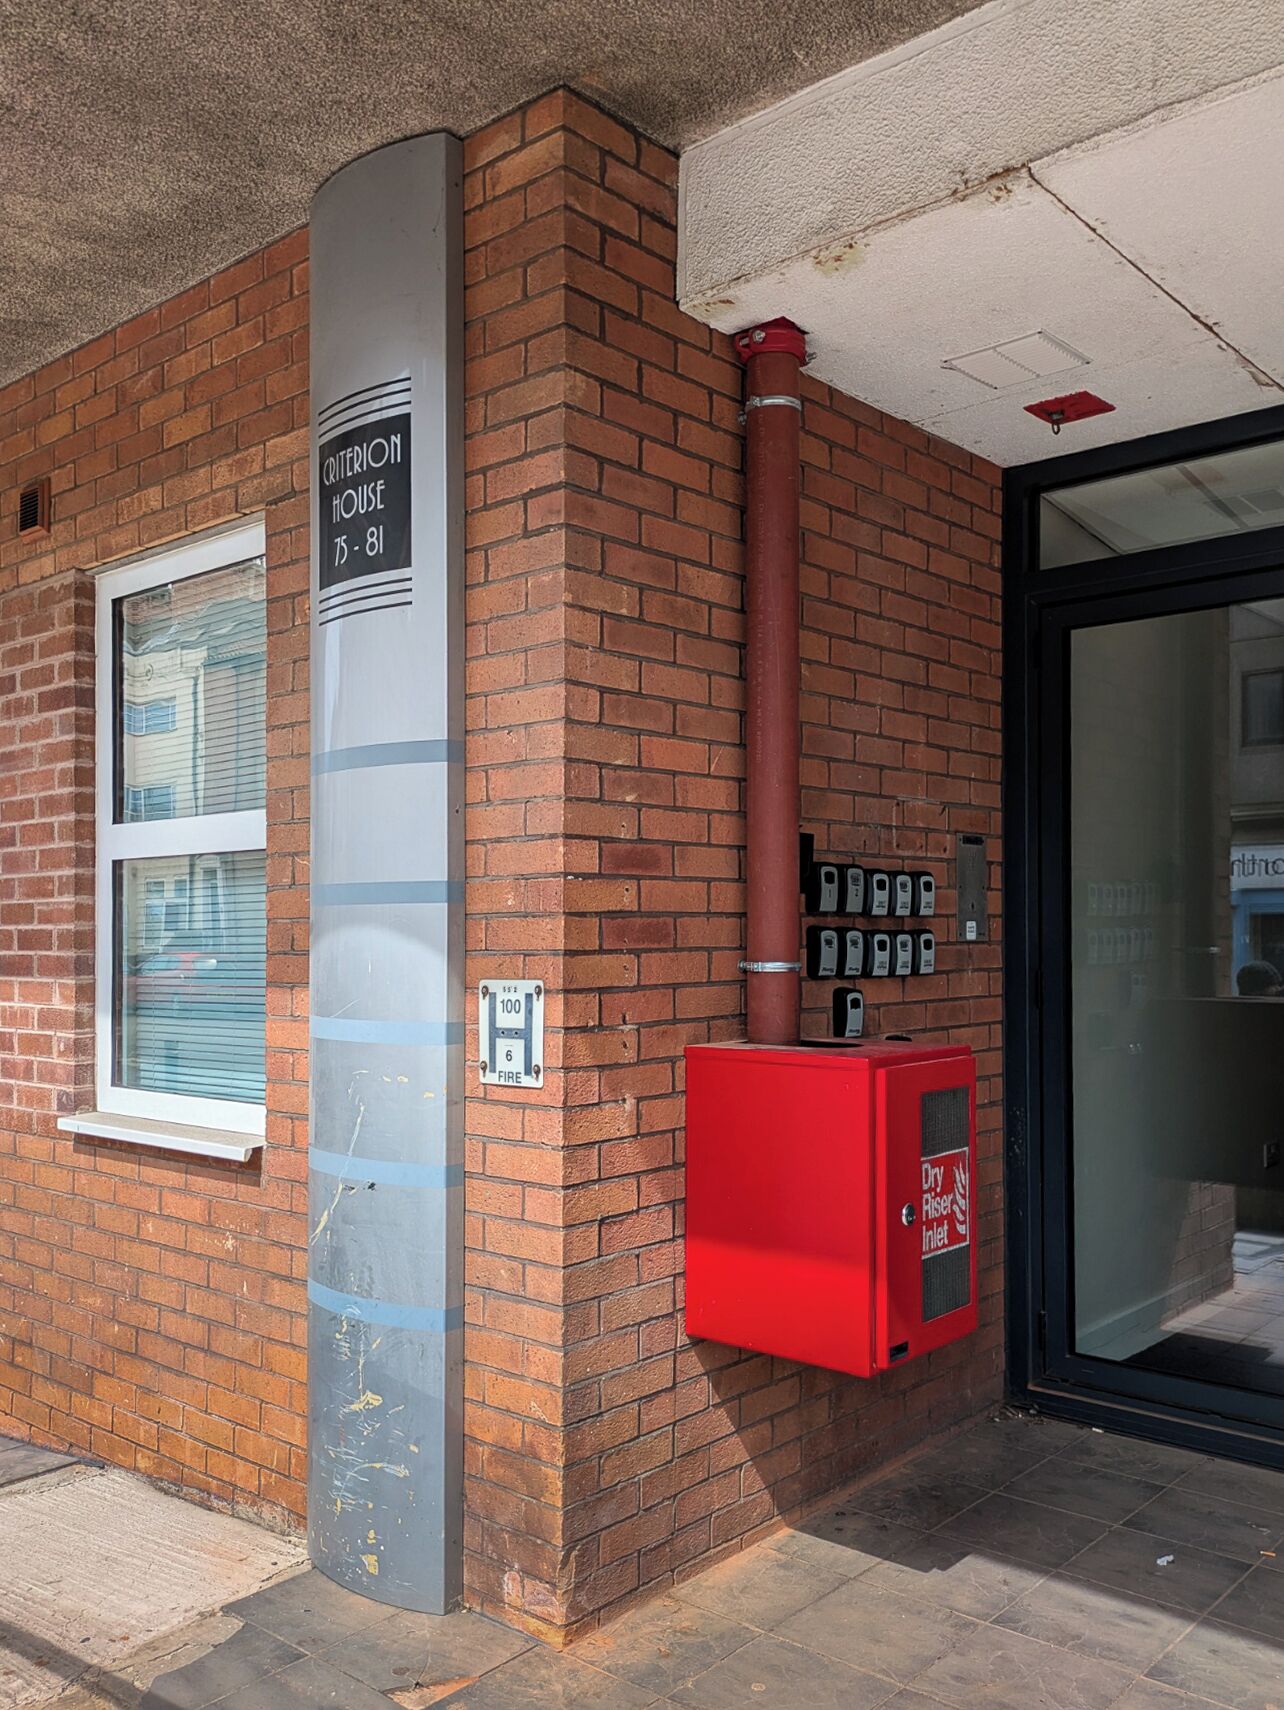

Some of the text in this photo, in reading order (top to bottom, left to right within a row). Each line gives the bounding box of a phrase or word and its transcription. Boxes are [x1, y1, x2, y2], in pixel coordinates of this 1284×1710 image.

[323, 433, 401, 486] CRITERION
[332, 480, 385, 524] HOUSE
[334, 535, 348, 567] 75
[365, 525, 383, 556] 81
[500, 999, 521, 1014] 100
[505, 1049, 513, 1062] 6
[498, 1070, 522, 1084] FIRE
[922, 1162, 944, 1193] Dry
[922, 1192, 953, 1222] Riser
[922, 1220, 948, 1252] Inlet
